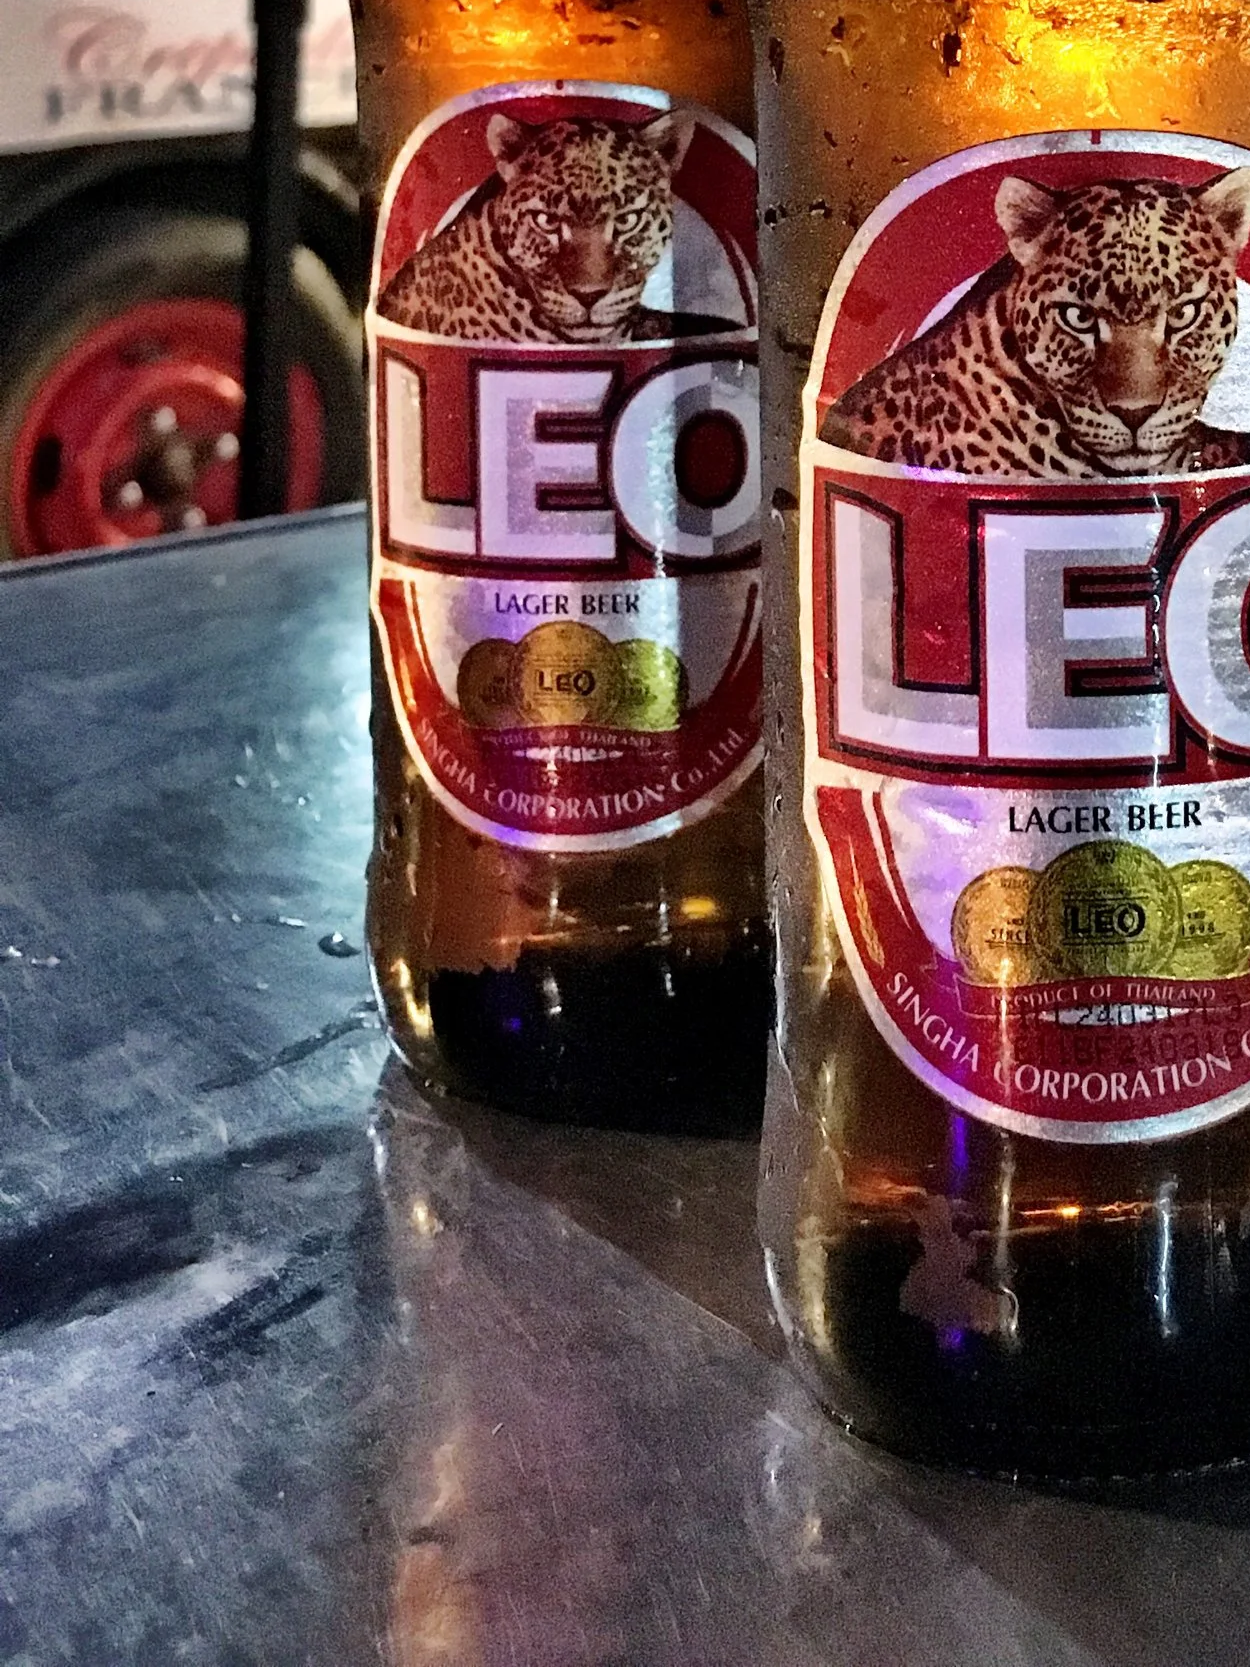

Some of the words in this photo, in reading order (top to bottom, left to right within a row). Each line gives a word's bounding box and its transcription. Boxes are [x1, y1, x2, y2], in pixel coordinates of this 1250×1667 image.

[377, 350, 762, 572] LEO
[494, 592, 569, 616] LAGER
[580, 593, 641, 616] BEER
[537, 669, 597, 697] LEO
[484, 783, 666, 820] CORPORATION
[1008, 805, 1112, 835] LAGER
[1127, 799, 1203, 833] BEER
[1065, 902, 1147, 939] LEO
[1089, 984, 1114, 1000] OF
[1125, 982, 1217, 1004] THAILAND
[886, 971, 980, 1073] SINGHA
[993, 1046, 1233, 1103] CORPORATION
